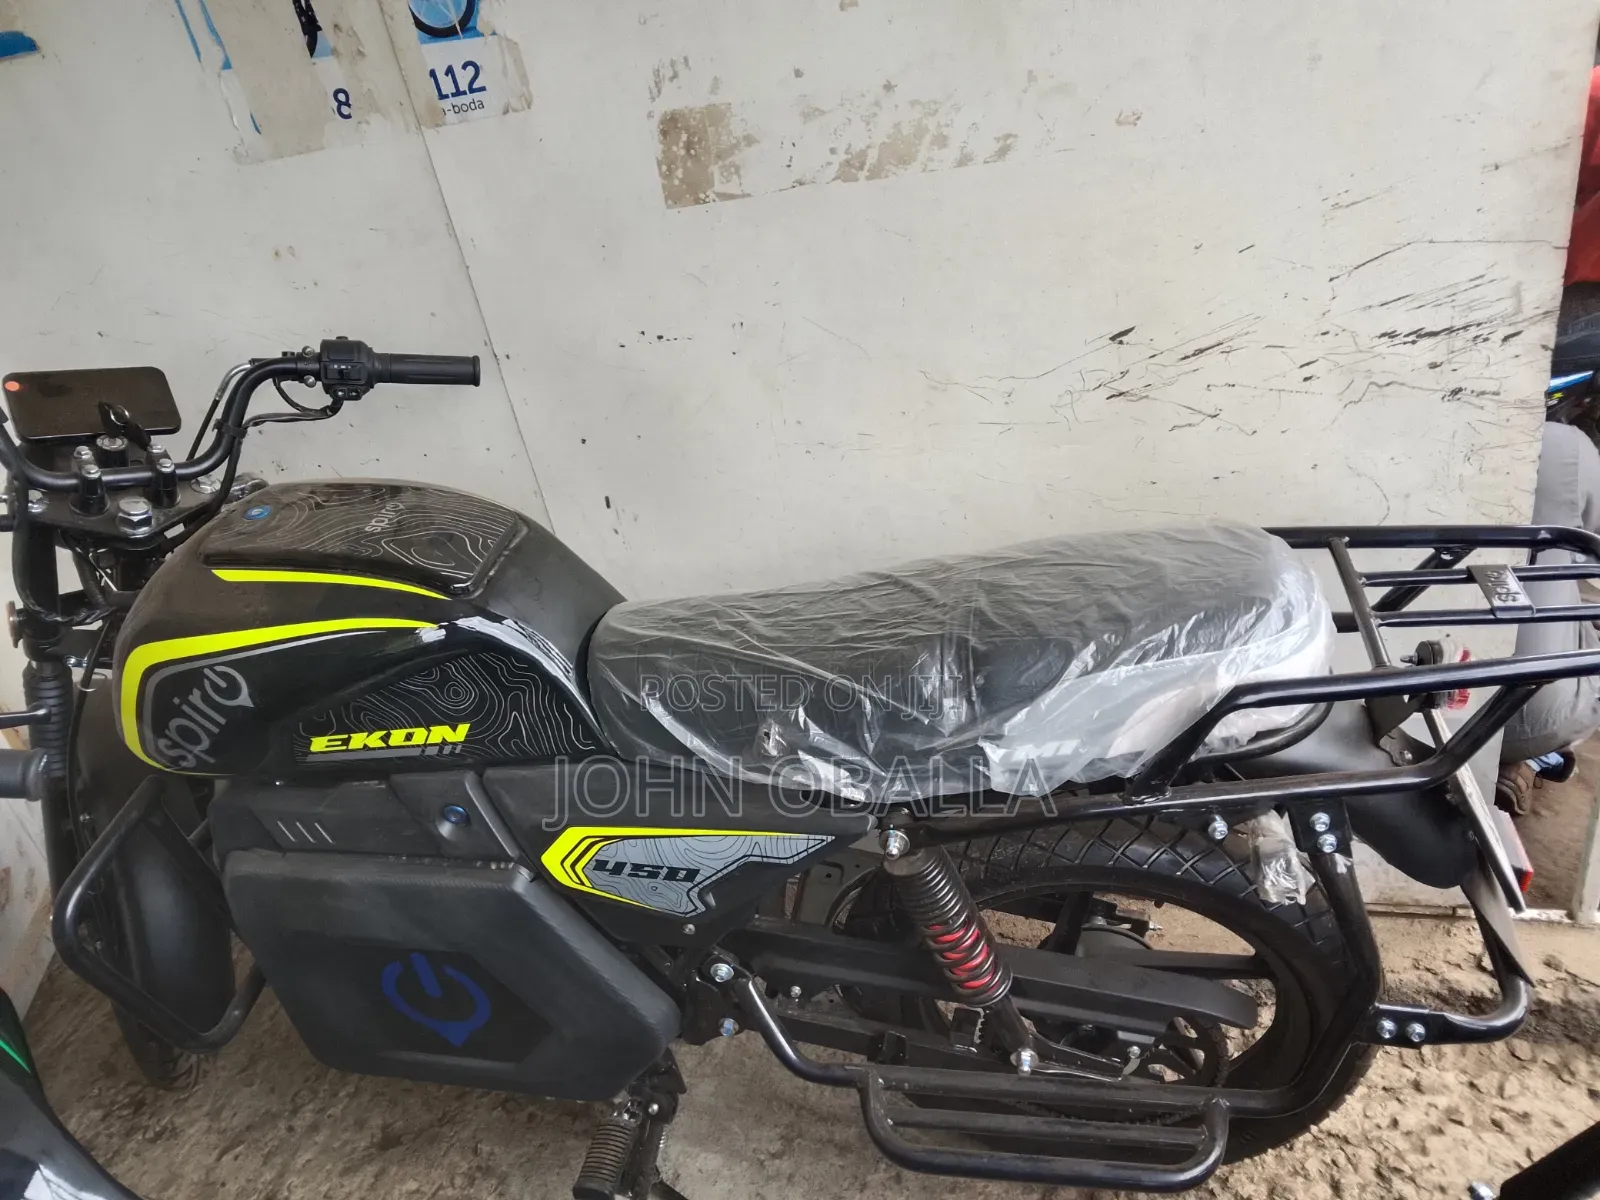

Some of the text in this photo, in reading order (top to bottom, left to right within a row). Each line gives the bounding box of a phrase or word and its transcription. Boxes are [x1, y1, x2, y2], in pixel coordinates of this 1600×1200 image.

[429, 60, 487, 100] 112
[157, 665, 254, 768] spiro
[309, 723, 471, 752] EKON
[593, 859, 700, 882] 450
